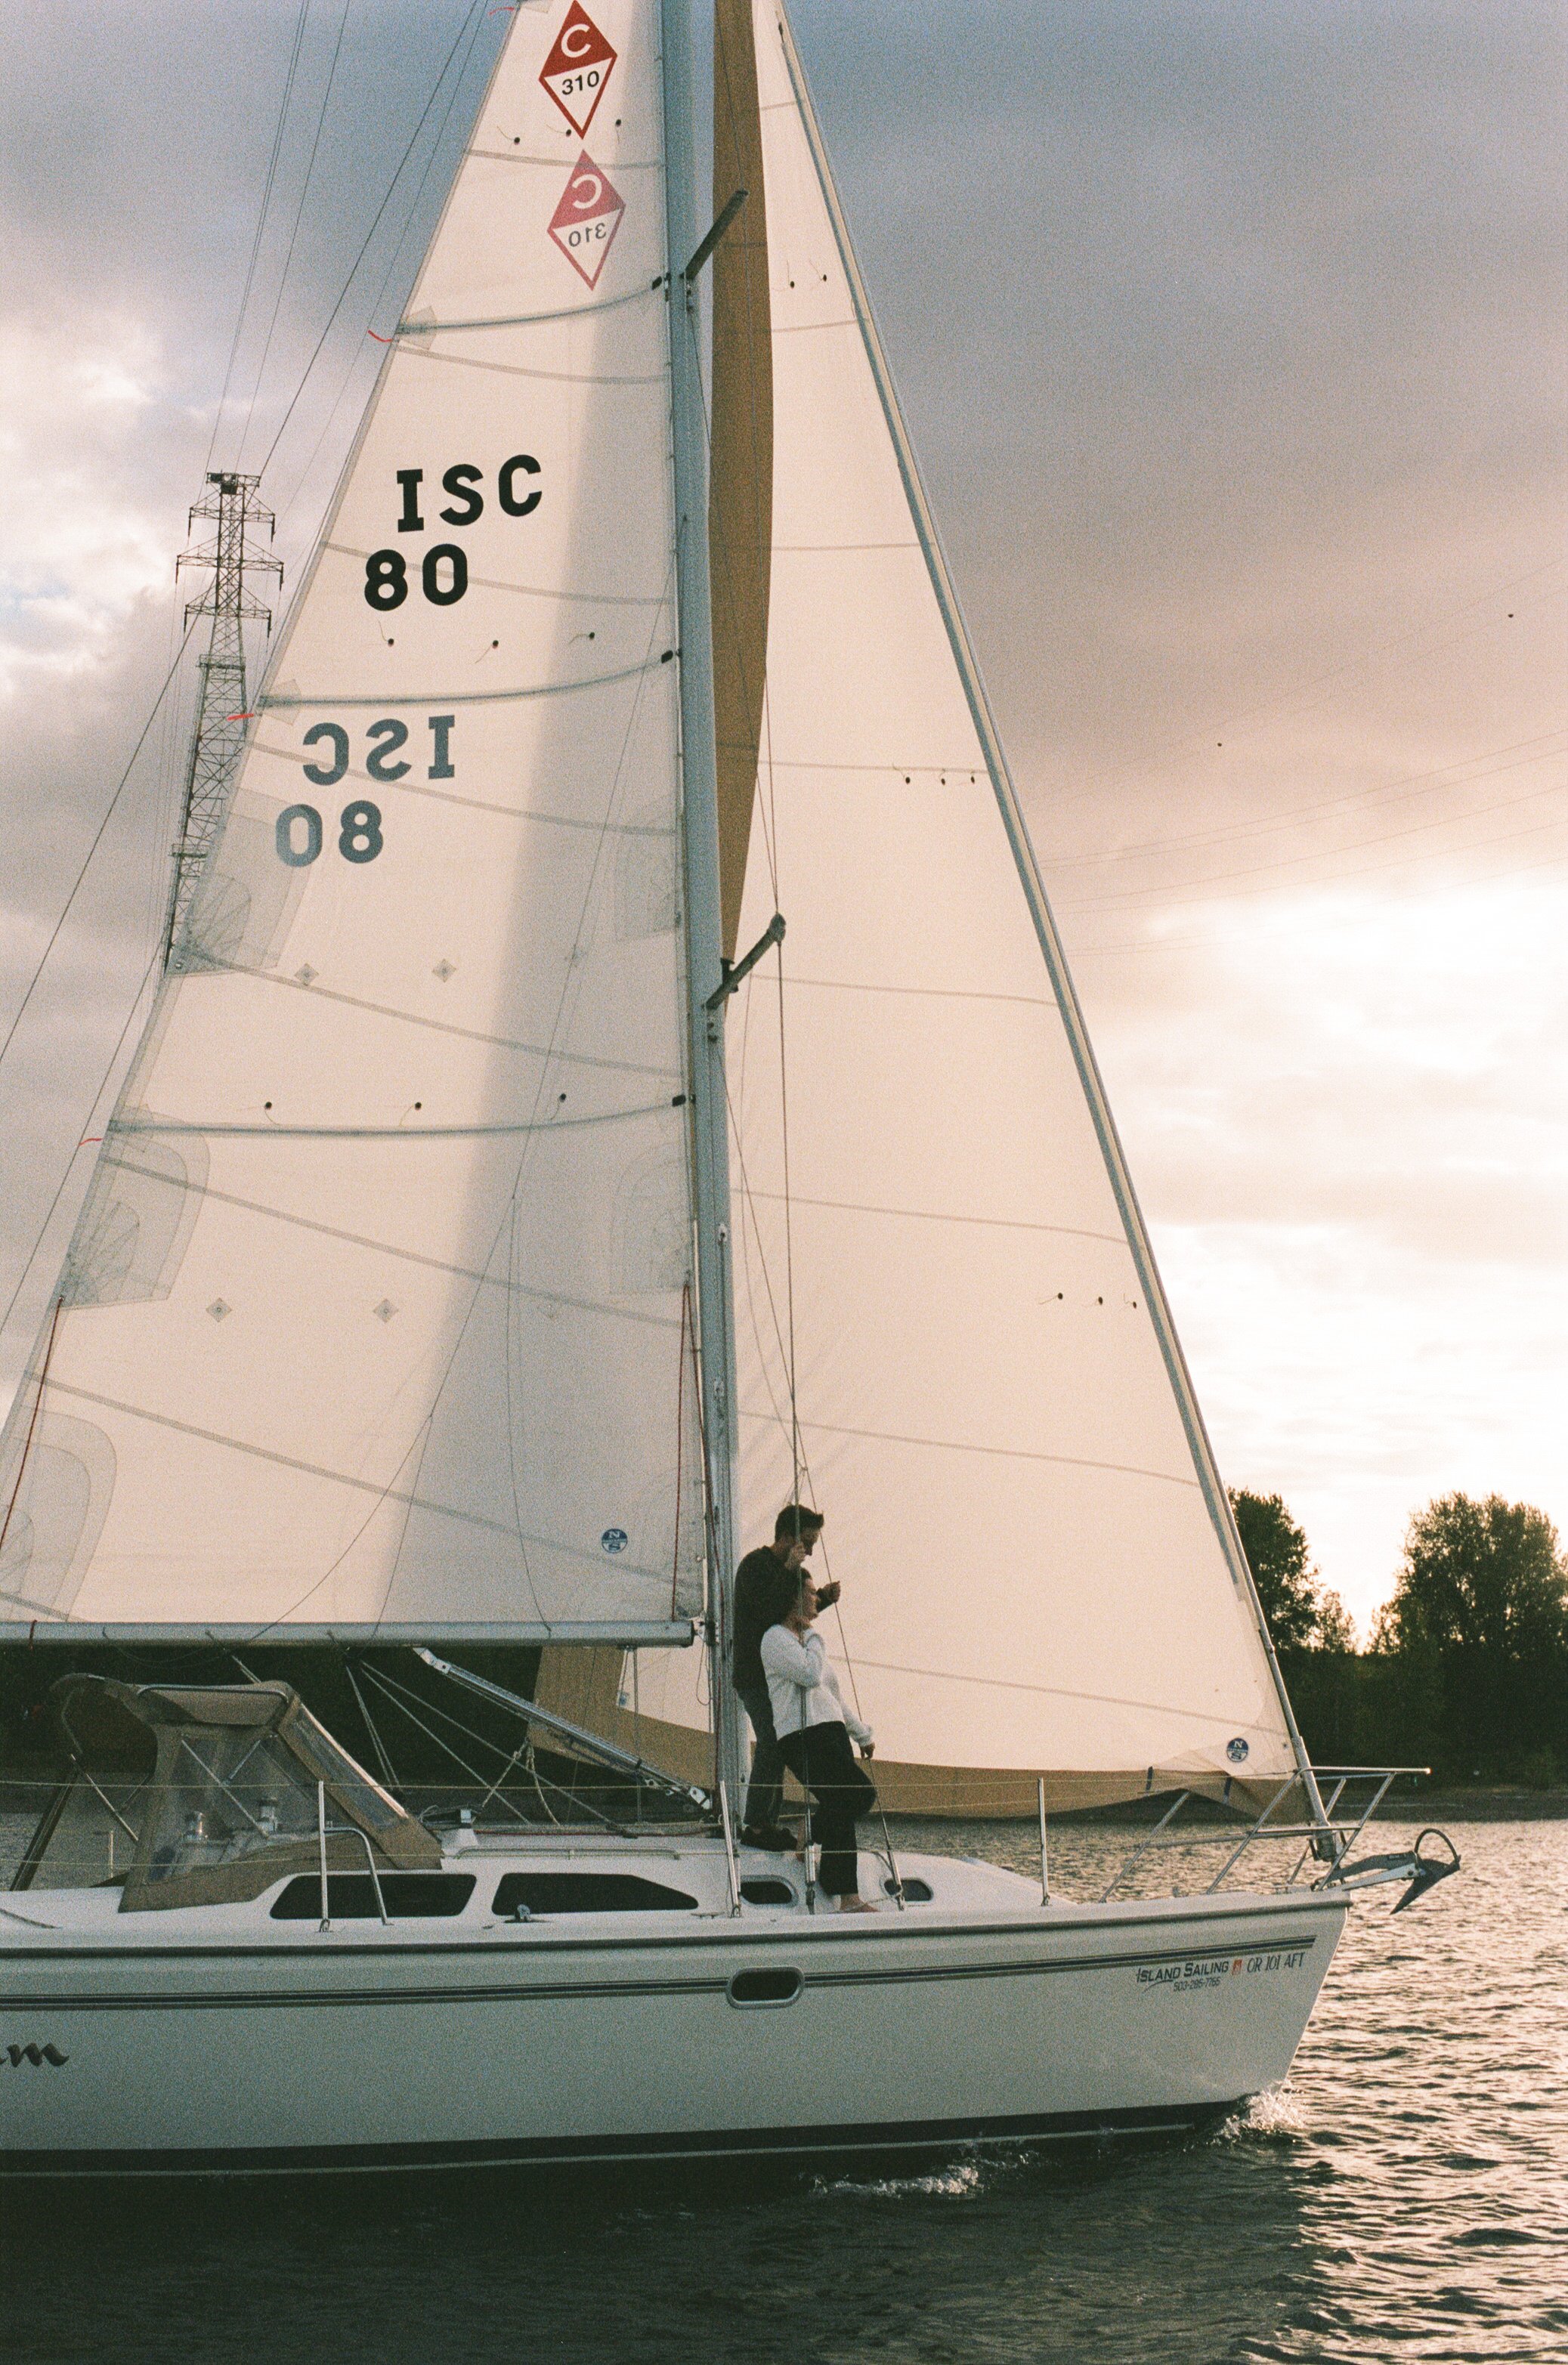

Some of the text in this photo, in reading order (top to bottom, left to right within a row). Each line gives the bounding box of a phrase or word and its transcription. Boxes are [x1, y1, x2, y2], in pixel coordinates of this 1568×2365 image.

[561, 23, 592, 58] C
[561, 70, 600, 95] 310
[396, 454, 543, 533] ISC
[364, 543, 469, 611] 80
[1247, 1957, 1263, 1973] OR
[1284, 1952, 1306, 1969] AFT
